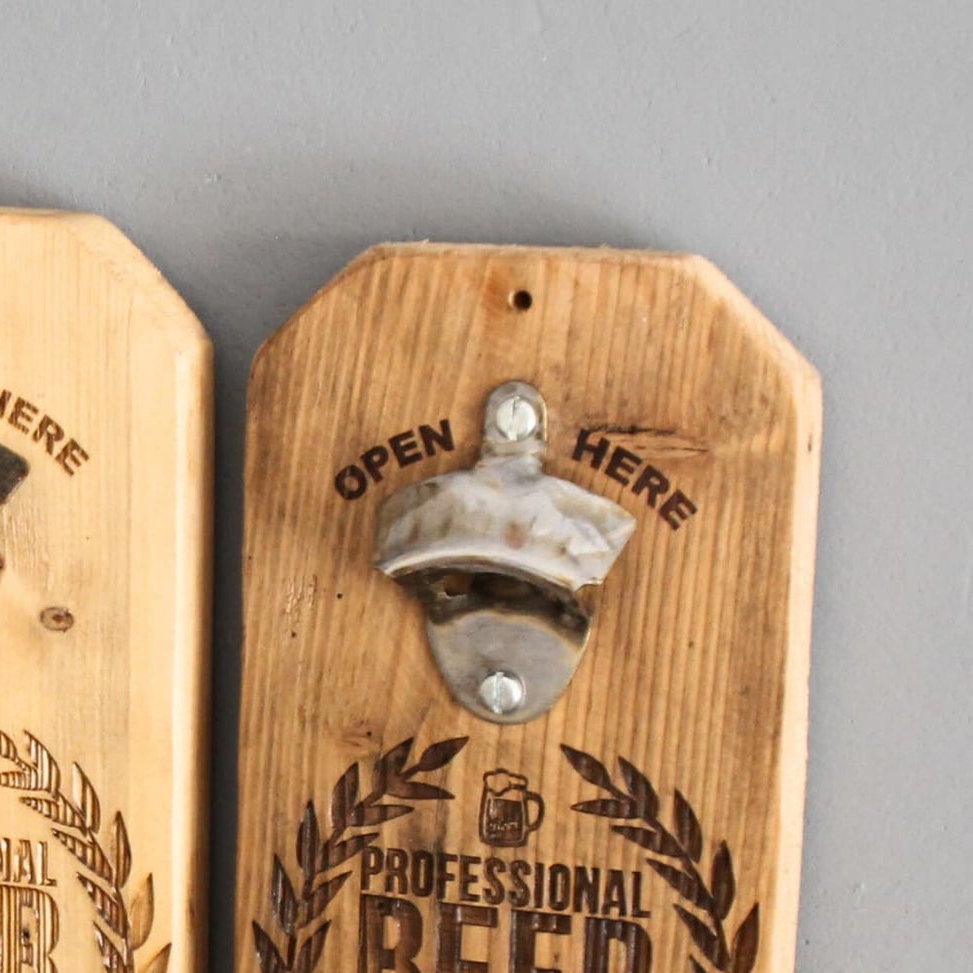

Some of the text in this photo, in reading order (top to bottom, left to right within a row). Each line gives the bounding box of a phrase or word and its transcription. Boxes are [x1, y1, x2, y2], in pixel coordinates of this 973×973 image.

[333, 418, 699, 531] OPEN HERE
[361, 844, 651, 919] PROFESSIONAL
